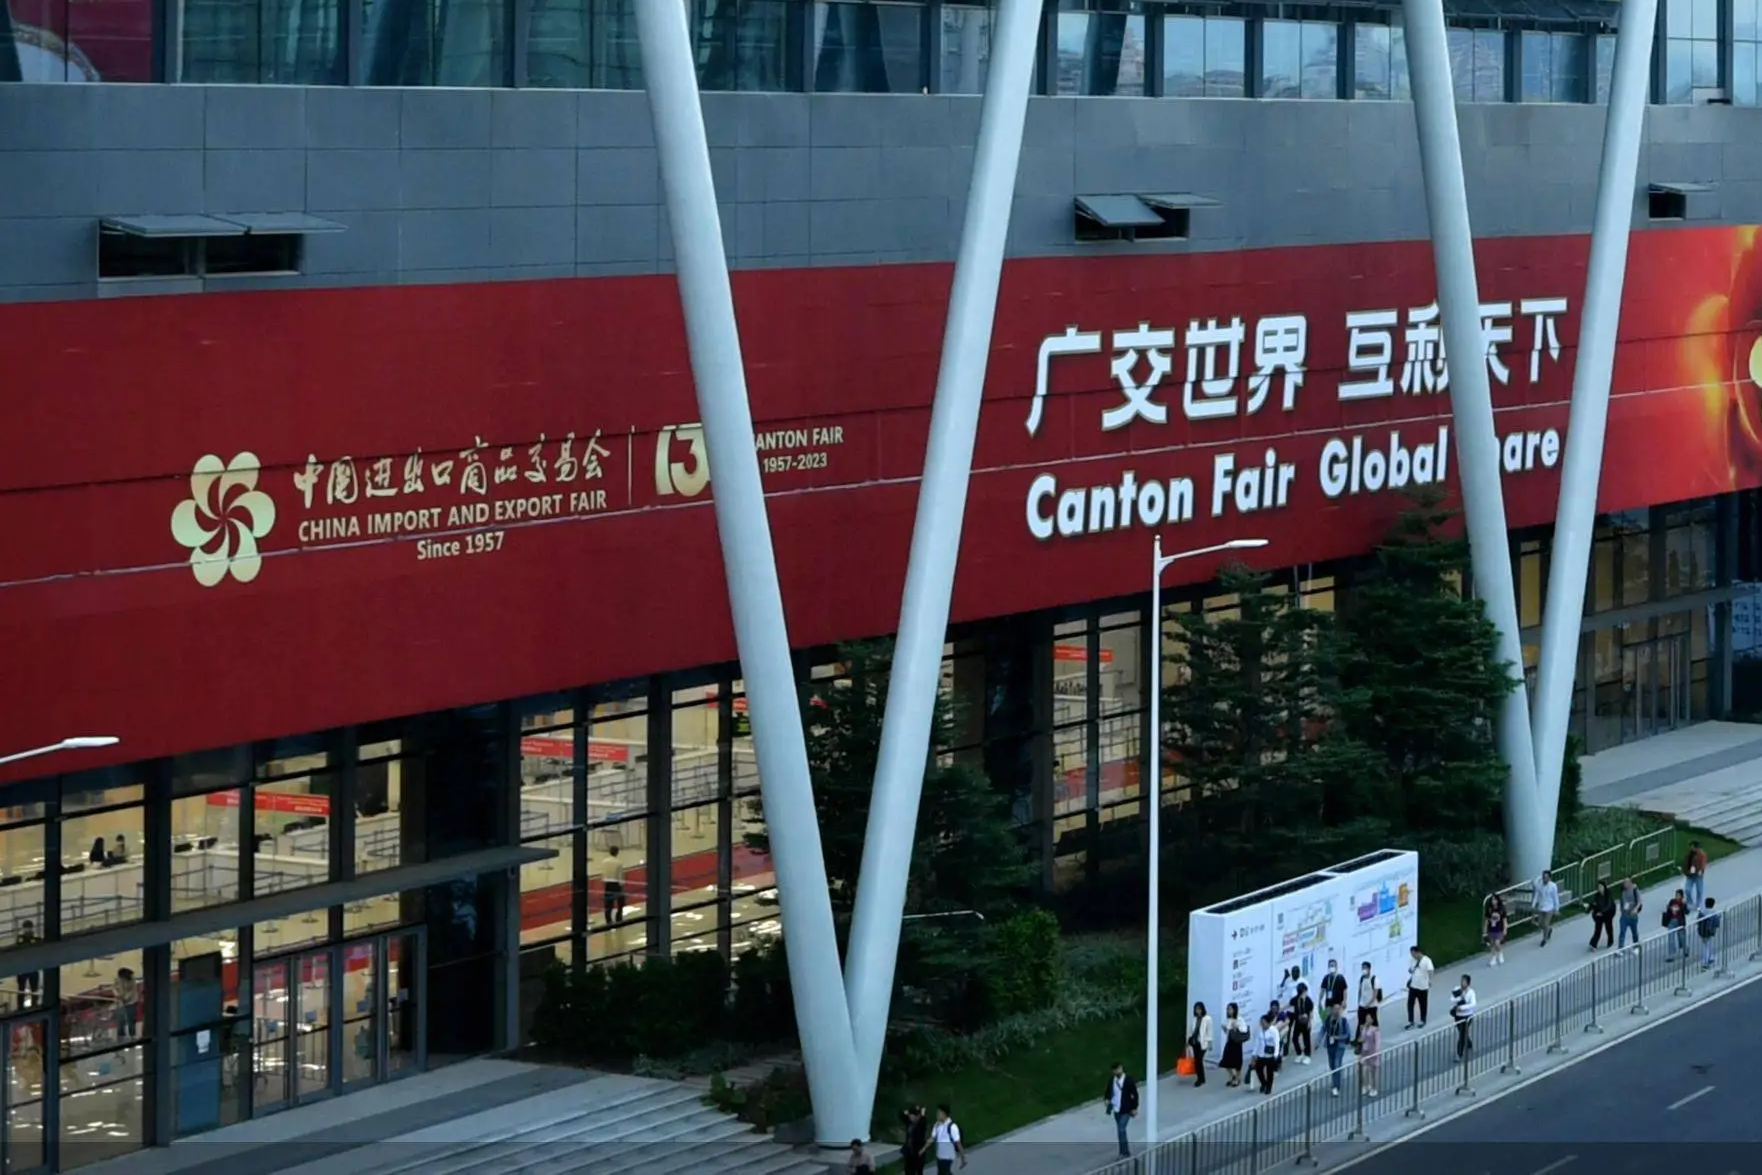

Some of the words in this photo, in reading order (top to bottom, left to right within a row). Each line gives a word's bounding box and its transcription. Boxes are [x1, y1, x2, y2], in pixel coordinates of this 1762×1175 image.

[1026, 314, 1308, 437] 广交世界
[753, 429, 808, 452] ANTON
[812, 425, 844, 446] FAIR
[762, 451, 828, 473] 1957-2023
[1026, 471, 1194, 539] Canton
[1211, 446, 1296, 517] Fair
[1319, 425, 1448, 498] Global
[1494, 427, 1560, 473] are
[299, 519, 361, 542] CHINA
[367, 507, 442, 534] IMPORT
[447, 502, 490, 526] AND
[494, 494, 563, 521] EXPORT
[569, 489, 608, 511] FAIR
[417, 538, 460, 560] Since
[465, 531, 505, 555] 1957
